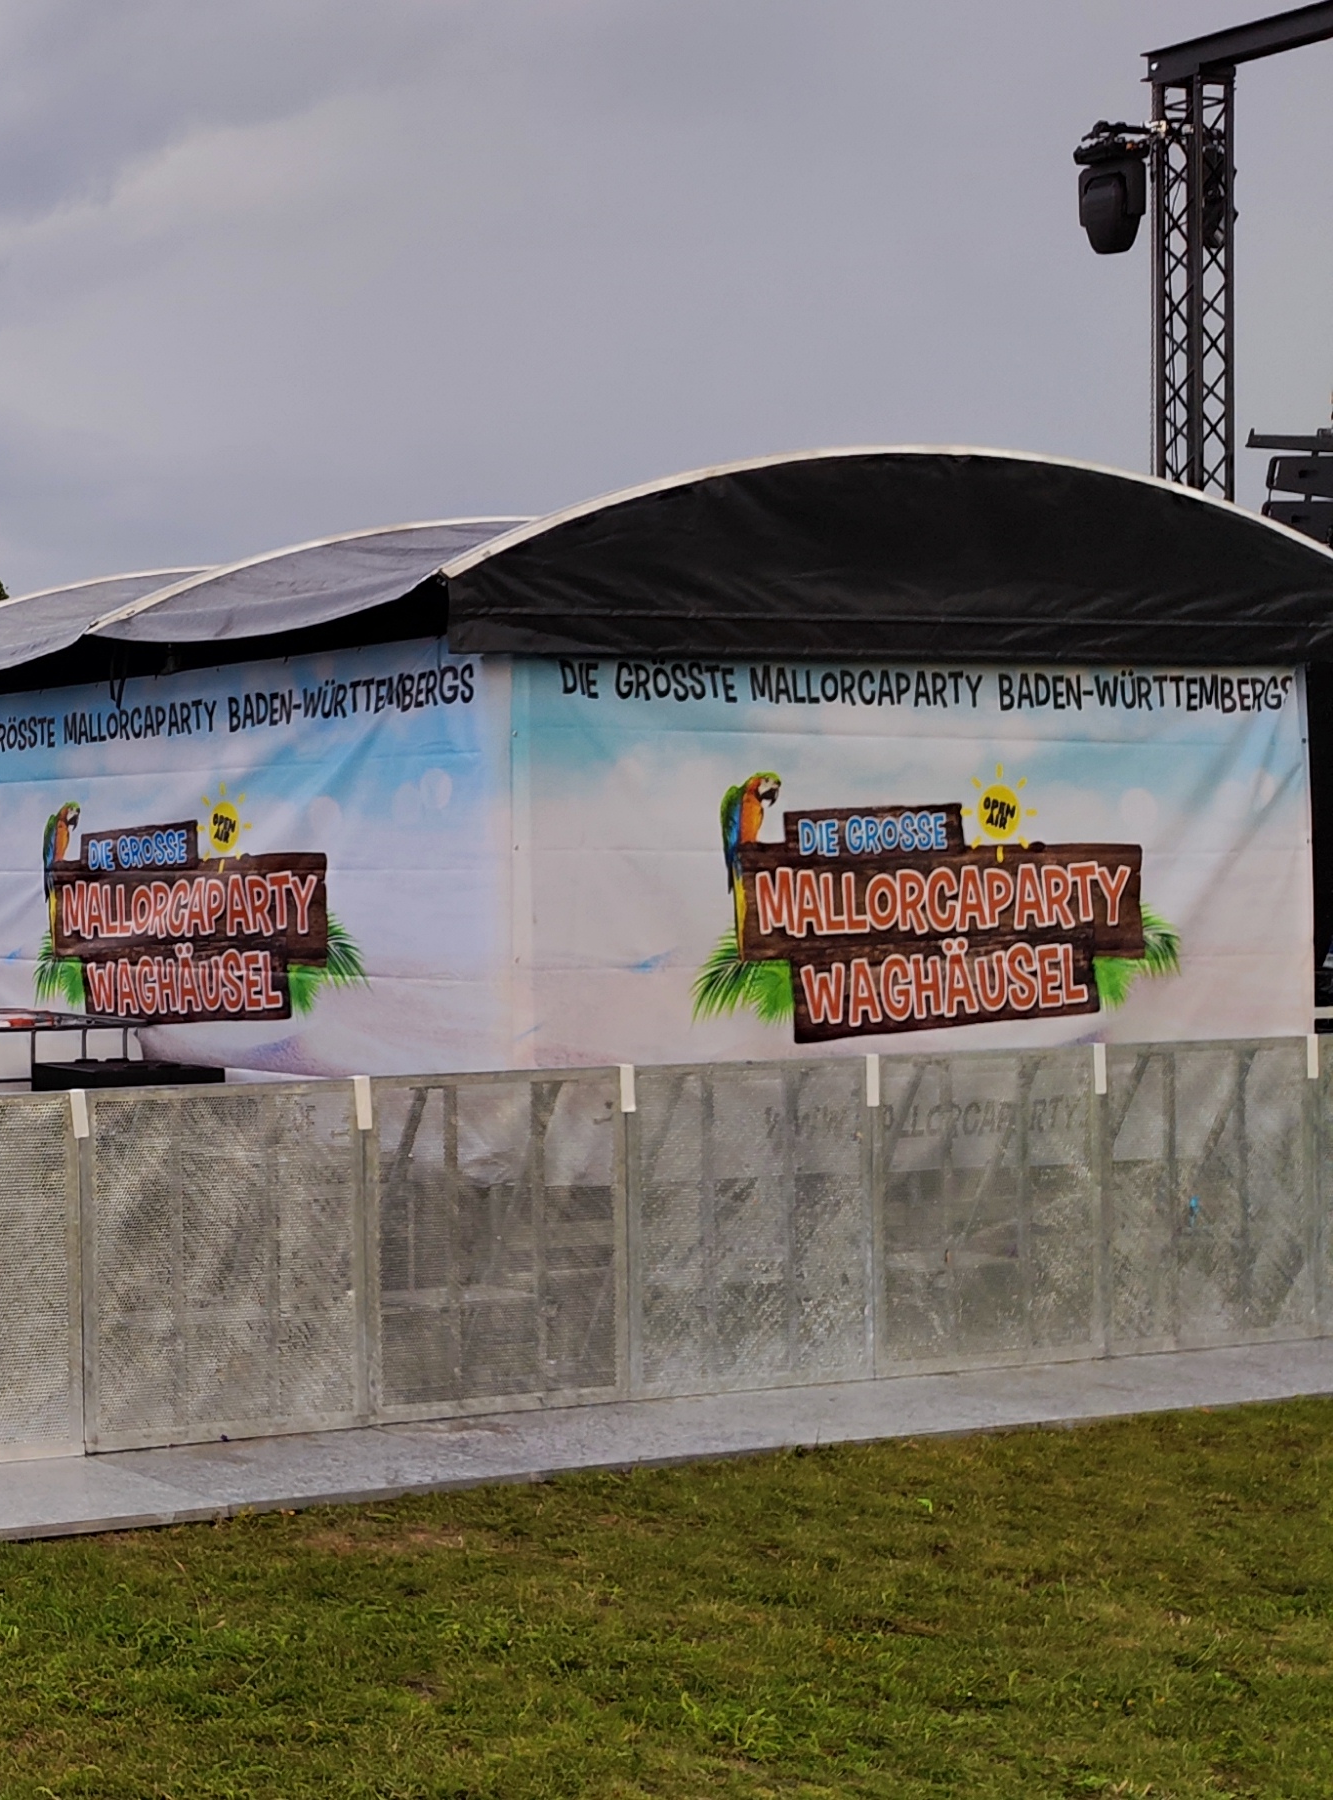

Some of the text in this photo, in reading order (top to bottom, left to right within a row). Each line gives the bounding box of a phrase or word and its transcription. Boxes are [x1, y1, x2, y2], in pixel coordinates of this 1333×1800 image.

[63, 698, 217, 746] MALLORCAPARTY
[228, 663, 474, 733] BADEN-WÜRTTEMBERGS
[558, 659, 600, 699] DIE
[615, 658, 738, 703] GRÖSSTE
[749, 665, 983, 708] MALLORCAPARTY
[213, 813, 236, 833] OPEN
[983, 797, 1016, 818] OPEN
[985, 813, 1008, 830] AIR
[88, 829, 187, 871] DIE GROSSE
[214, 829, 230, 844] AIR
[798, 811, 948, 856] DIE GROSSE
[62, 871, 317, 939] MALLORCAPARTY
[755, 861, 1131, 938] MALLORCAPARTY
[87, 942, 282, 1016] WAGHÄUSEL
[800, 936, 1088, 1027] WAGHÄUSEL
